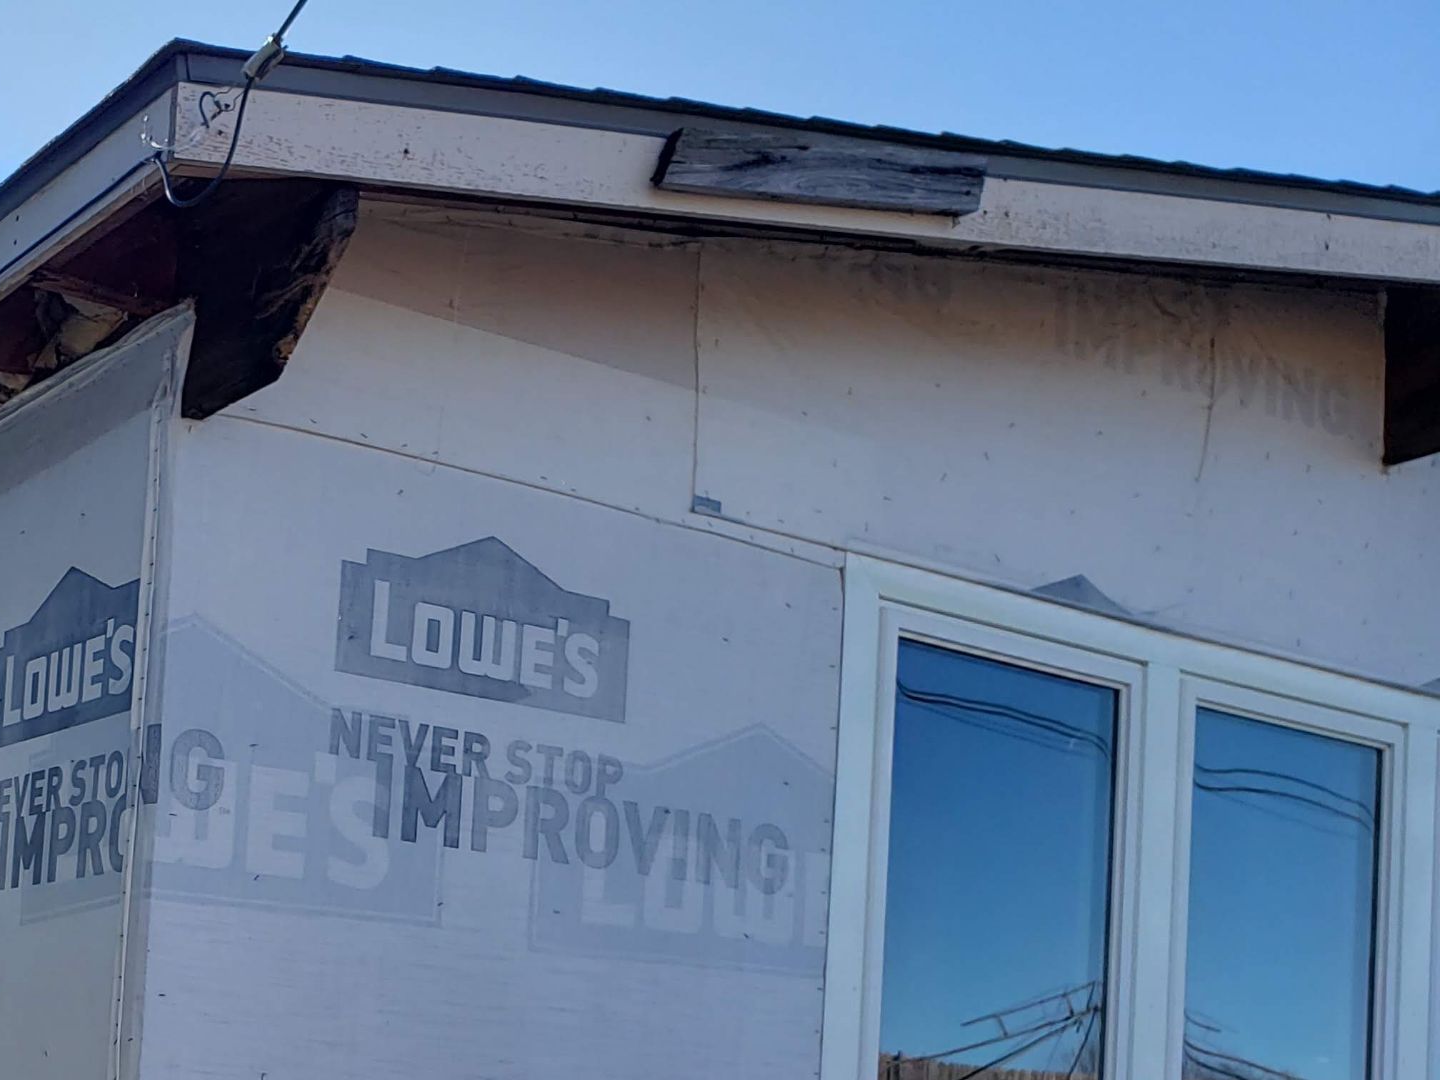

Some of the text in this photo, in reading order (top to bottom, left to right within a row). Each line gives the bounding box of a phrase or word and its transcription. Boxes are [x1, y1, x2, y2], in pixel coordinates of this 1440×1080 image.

[3, 617, 134, 727] LOWE'S
[370, 579, 598, 697] LOWE'S
[70, 749, 128, 806] STO
[329, 708, 624, 798] NEVER STOP
[372, 757, 789, 895] IMPROVING
